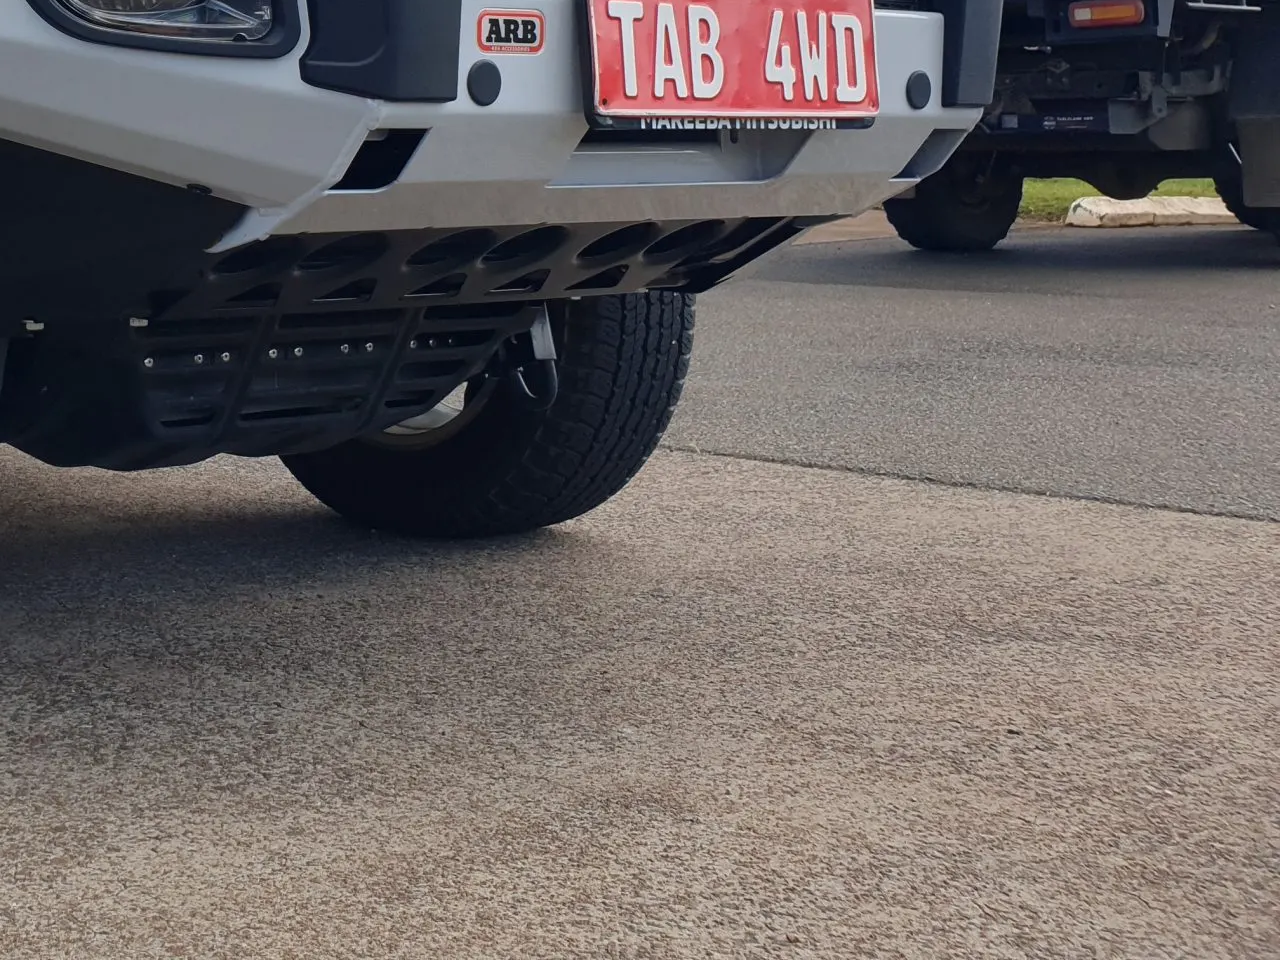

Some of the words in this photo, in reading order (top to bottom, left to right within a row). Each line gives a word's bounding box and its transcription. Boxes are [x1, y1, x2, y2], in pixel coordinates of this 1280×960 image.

[485, 18, 537, 44] ARB
[607, 0, 725, 99] TAB
[764, 8, 868, 103] 4WD
